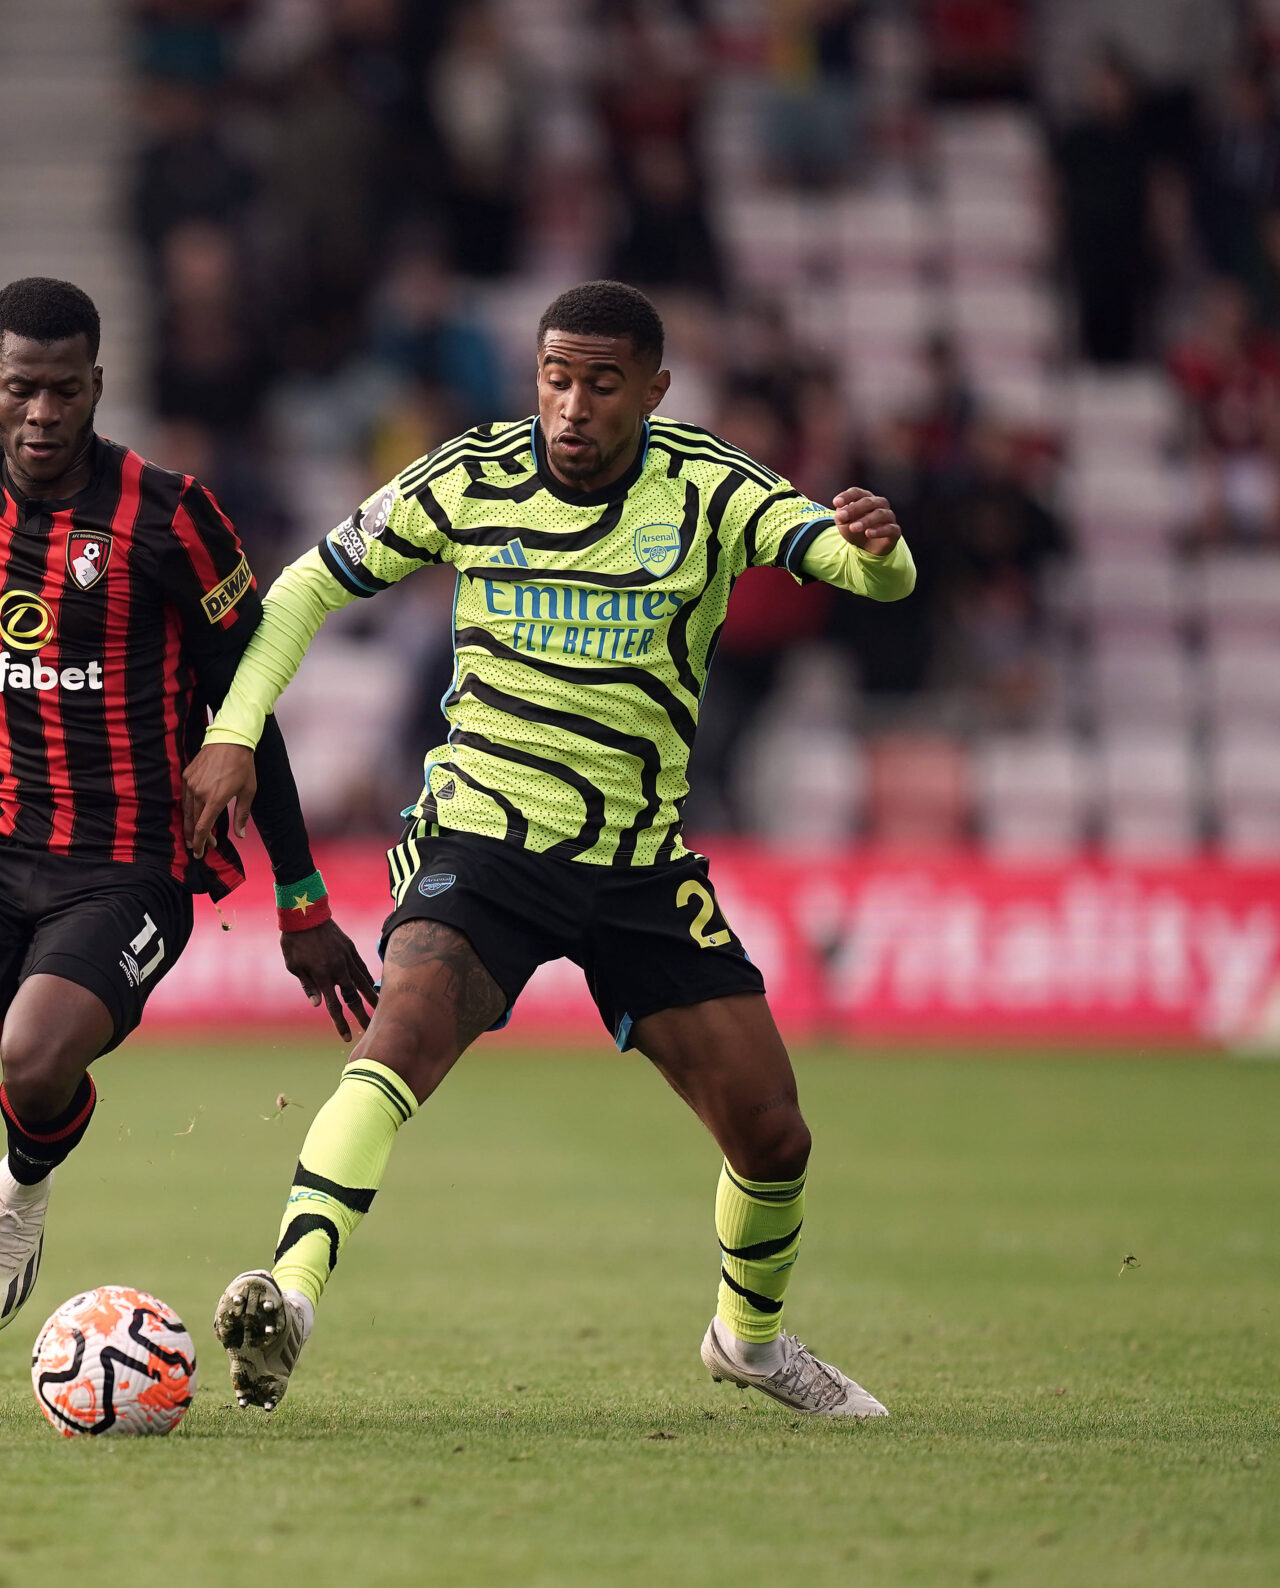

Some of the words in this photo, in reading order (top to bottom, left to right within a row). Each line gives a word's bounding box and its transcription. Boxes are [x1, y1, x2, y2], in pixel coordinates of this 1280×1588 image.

[339, 532, 362, 566] racism
[347, 525, 366, 556] room
[641, 532, 675, 544] Arsenal
[205, 560, 251, 617] DEWAL
[483, 577, 688, 622] Emirates
[513, 622, 555, 653] FLY
[562, 626, 655, 660] BETTER
[676, 879, 731, 949] 2
[129, 911, 165, 983] 11
[118, 960, 135, 988] umbro
